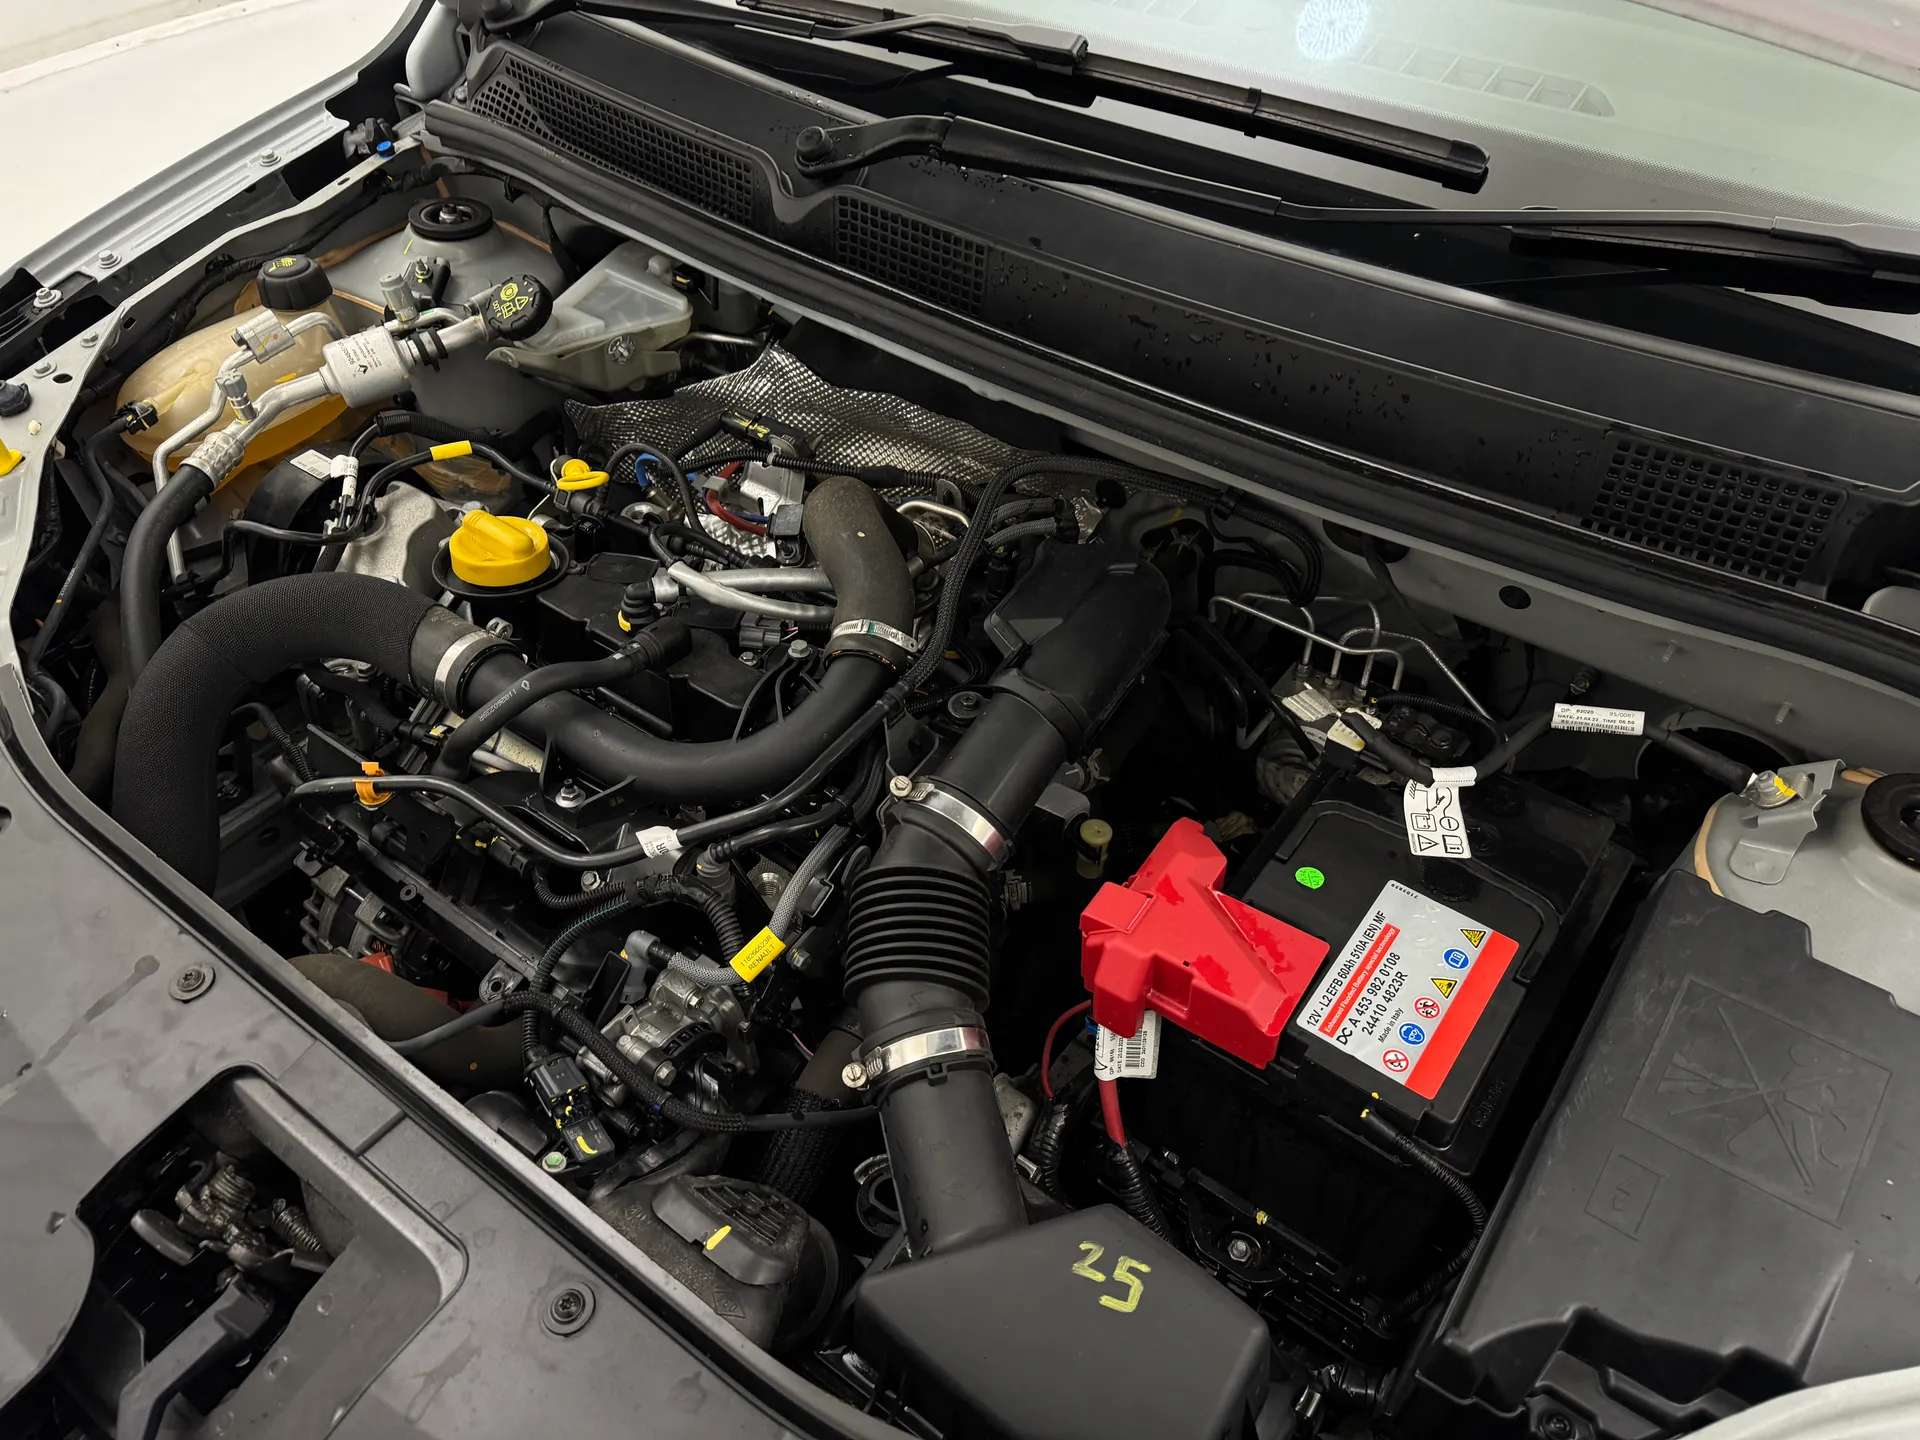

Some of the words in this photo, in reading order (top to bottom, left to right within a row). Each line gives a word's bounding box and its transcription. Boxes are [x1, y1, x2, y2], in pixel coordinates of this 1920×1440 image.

[748, 944, 776, 970] RENAULT
[1306, 1010, 1322, 1027] 12V
[1319, 994, 1332, 1007] L2
[1326, 977, 1343, 996] EFB
[1336, 956, 1356, 980] 60Ah
[1349, 937, 1369, 960] 510A
[1363, 921, 1381, 942] (EN)
[1373, 909, 1385, 925] MF
[1347, 1015, 1360, 1027] A
[1354, 995, 1373, 1017] 453
[1366, 975, 1385, 996] 982
[1379, 951, 1400, 976] 0108
[1352, 968, 1368, 988] Battery
[1361, 1003, 1387, 1036] 24410
[1383, 971, 1408, 1003] 4823R
[1390, 1006, 1404, 1022] Italy
[1378, 1025, 1392, 1042] Made
[1386, 1018, 1395, 1027] in
[1071, 1239, 1152, 1313] 25
